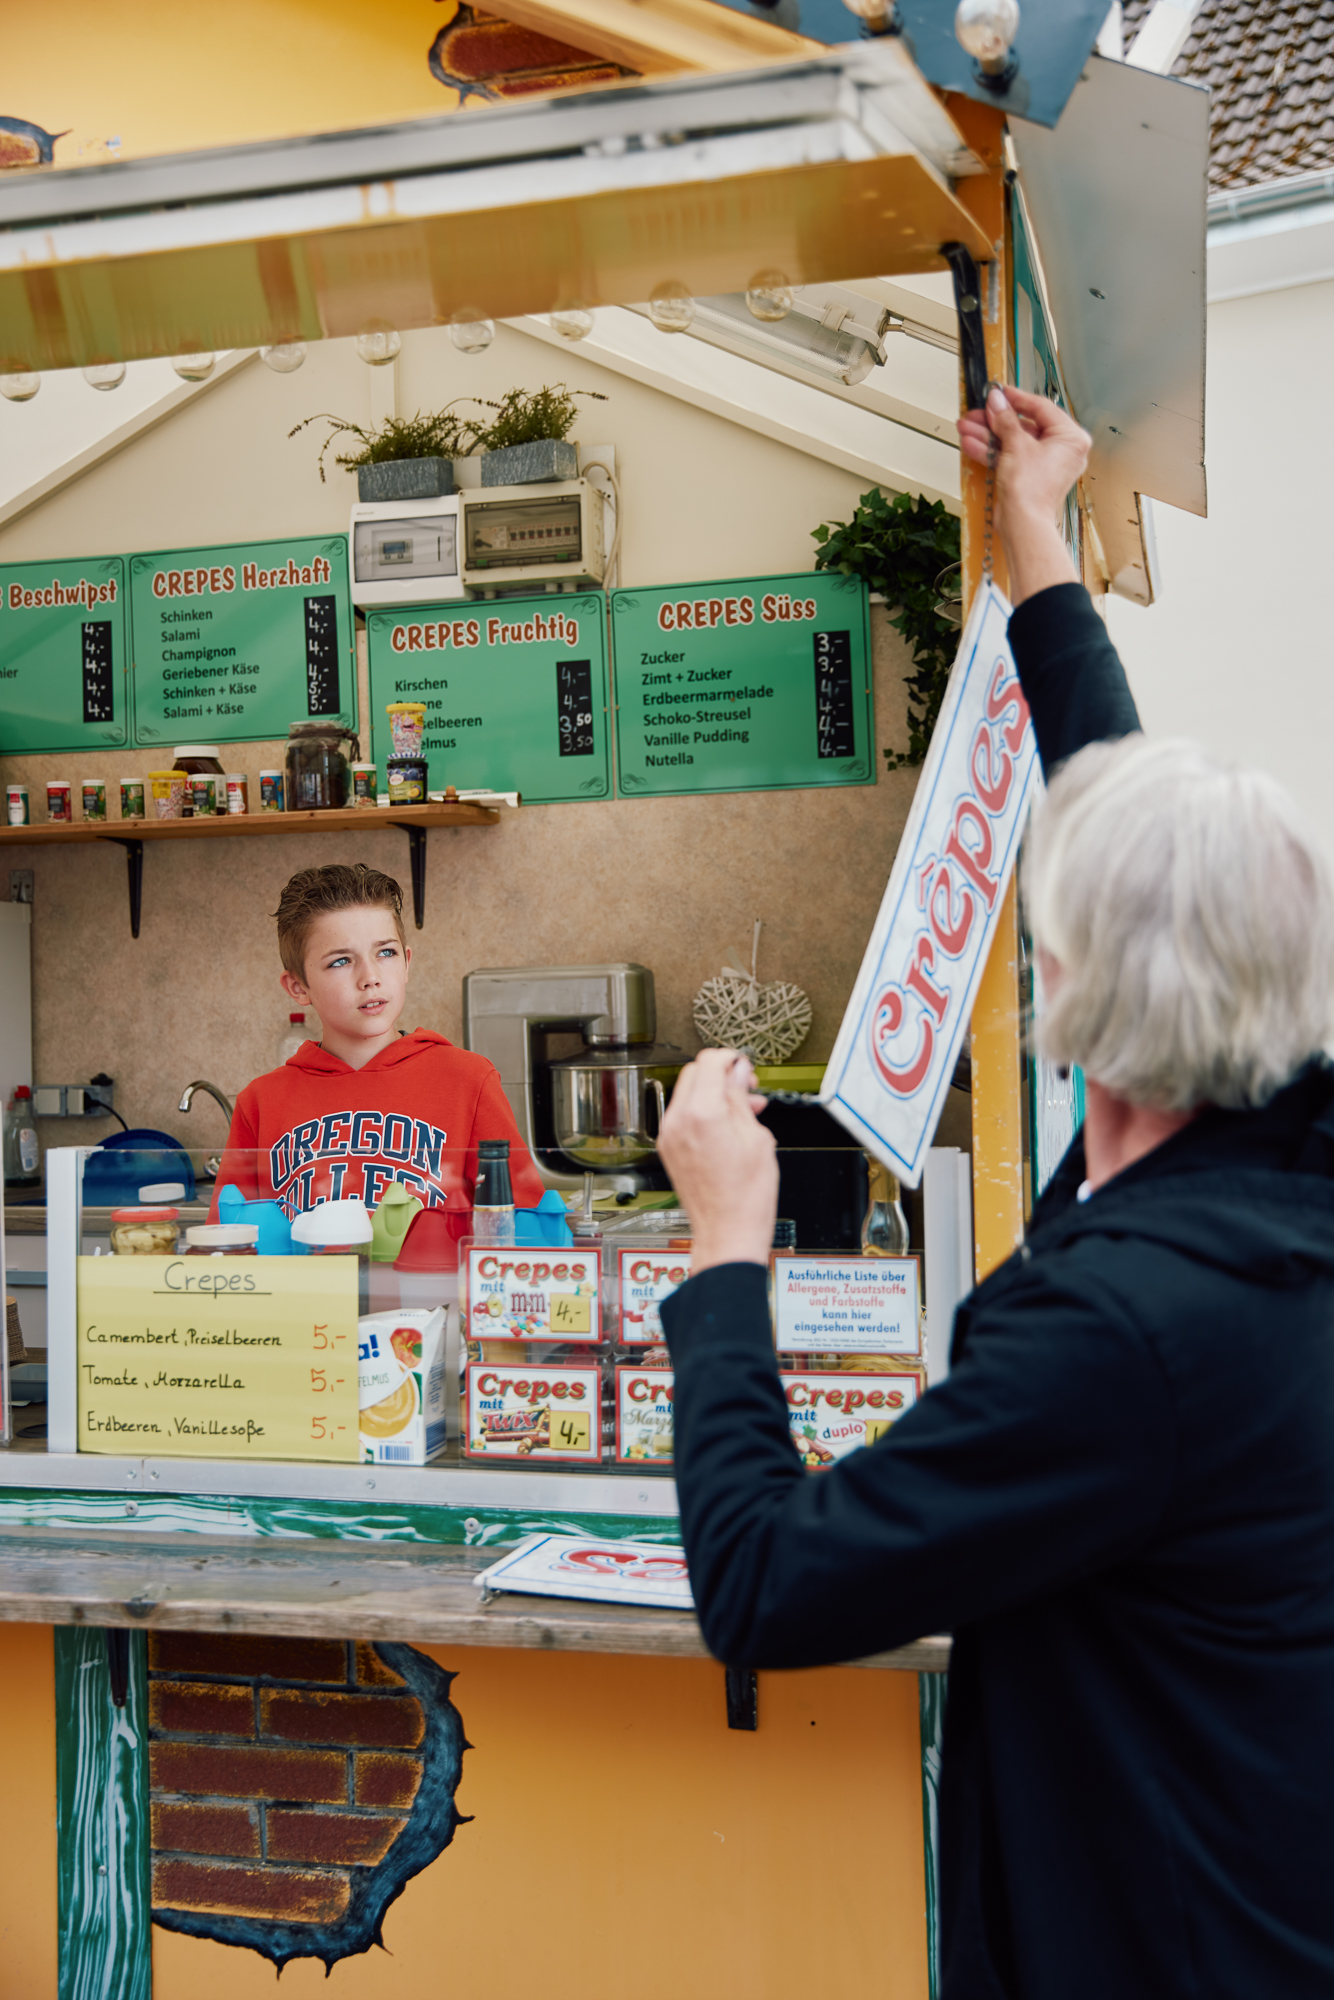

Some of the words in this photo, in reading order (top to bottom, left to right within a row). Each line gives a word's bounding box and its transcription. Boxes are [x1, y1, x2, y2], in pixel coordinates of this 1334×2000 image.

[152, 566, 236, 599] CREPES
[242, 556, 332, 591] Herzhaft
[9, 578, 117, 611] Beschwipst
[160, 609, 213, 624] Schinken
[658, 597, 754, 632] CREPES
[761, 593, 816, 624] Süss
[161, 628, 201, 642] Salami
[391, 619, 480, 653] CREPES
[487, 613, 579, 647] Fruchtig
[162, 645, 236, 662] Champignon
[641, 651, 685, 665] Zucker
[162, 665, 229, 681] Geriebener
[231, 662, 260, 676] Käse
[641, 672, 672, 686] Zimt
[675, 673, 684, 683] +
[687, 668, 732, 683] Zucker
[163, 685, 215, 700] Schinken
[219, 687, 226, 695] +
[229, 682, 257, 696] Käse
[395, 677, 448, 692] Kirschen
[643, 686, 774, 706] Erdbeermarmelade
[163, 705, 203, 719] Salami
[216, 702, 244, 716] Käse
[643, 707, 751, 727] Schoko-Streusel
[423, 716, 482, 730] selbeeren
[421, 737, 456, 750] elmus
[644, 731, 690, 748] Vanille
[693, 729, 750, 744] Pudding
[645, 753, 694, 767] Nutella
[868, 656, 1032, 1100] Crêpes
[270, 1111, 447, 1191] OREGON
[165, 1261, 256, 1299] Crepes
[478, 1256, 586, 1286] Crepes
[630, 1260, 690, 1285] Cre
[788, 1269, 852, 1281] Ausführliche
[854, 1270, 879, 1282] Liste
[882, 1271, 906, 1282] über
[480, 1281, 504, 1292] mit
[631, 1285, 654, 1296] mit
[787, 1282, 840, 1296] Allergene,
[843, 1283, 907, 1295] Zusatzstoffe
[809, 1295, 828, 1307] und
[832, 1296, 885, 1307] Farbstoffe
[557, 1300, 581, 1324] 4,-
[822, 1308, 848, 1319] kann
[851, 1309, 872, 1320] hier
[313, 1324, 347, 1350] 5,-
[794, 1322, 854, 1334] eingesehen
[857, 1323, 900, 1334] werden!
[359, 1333, 380, 1361] a!
[311, 1368, 345, 1392] 5,-
[359, 1372, 390, 1388] FELMUS
[477, 1372, 585, 1403] Crepes
[479, 1398, 503, 1410] mit
[655, 1402, 672, 1413] mi
[785, 1383, 903, 1414] Crepes
[789, 1409, 817, 1421] mit
[310, 1416, 346, 1440] 5,-
[560, 1419, 586, 1445] 4,-
[822, 1422, 863, 1439] duplo
